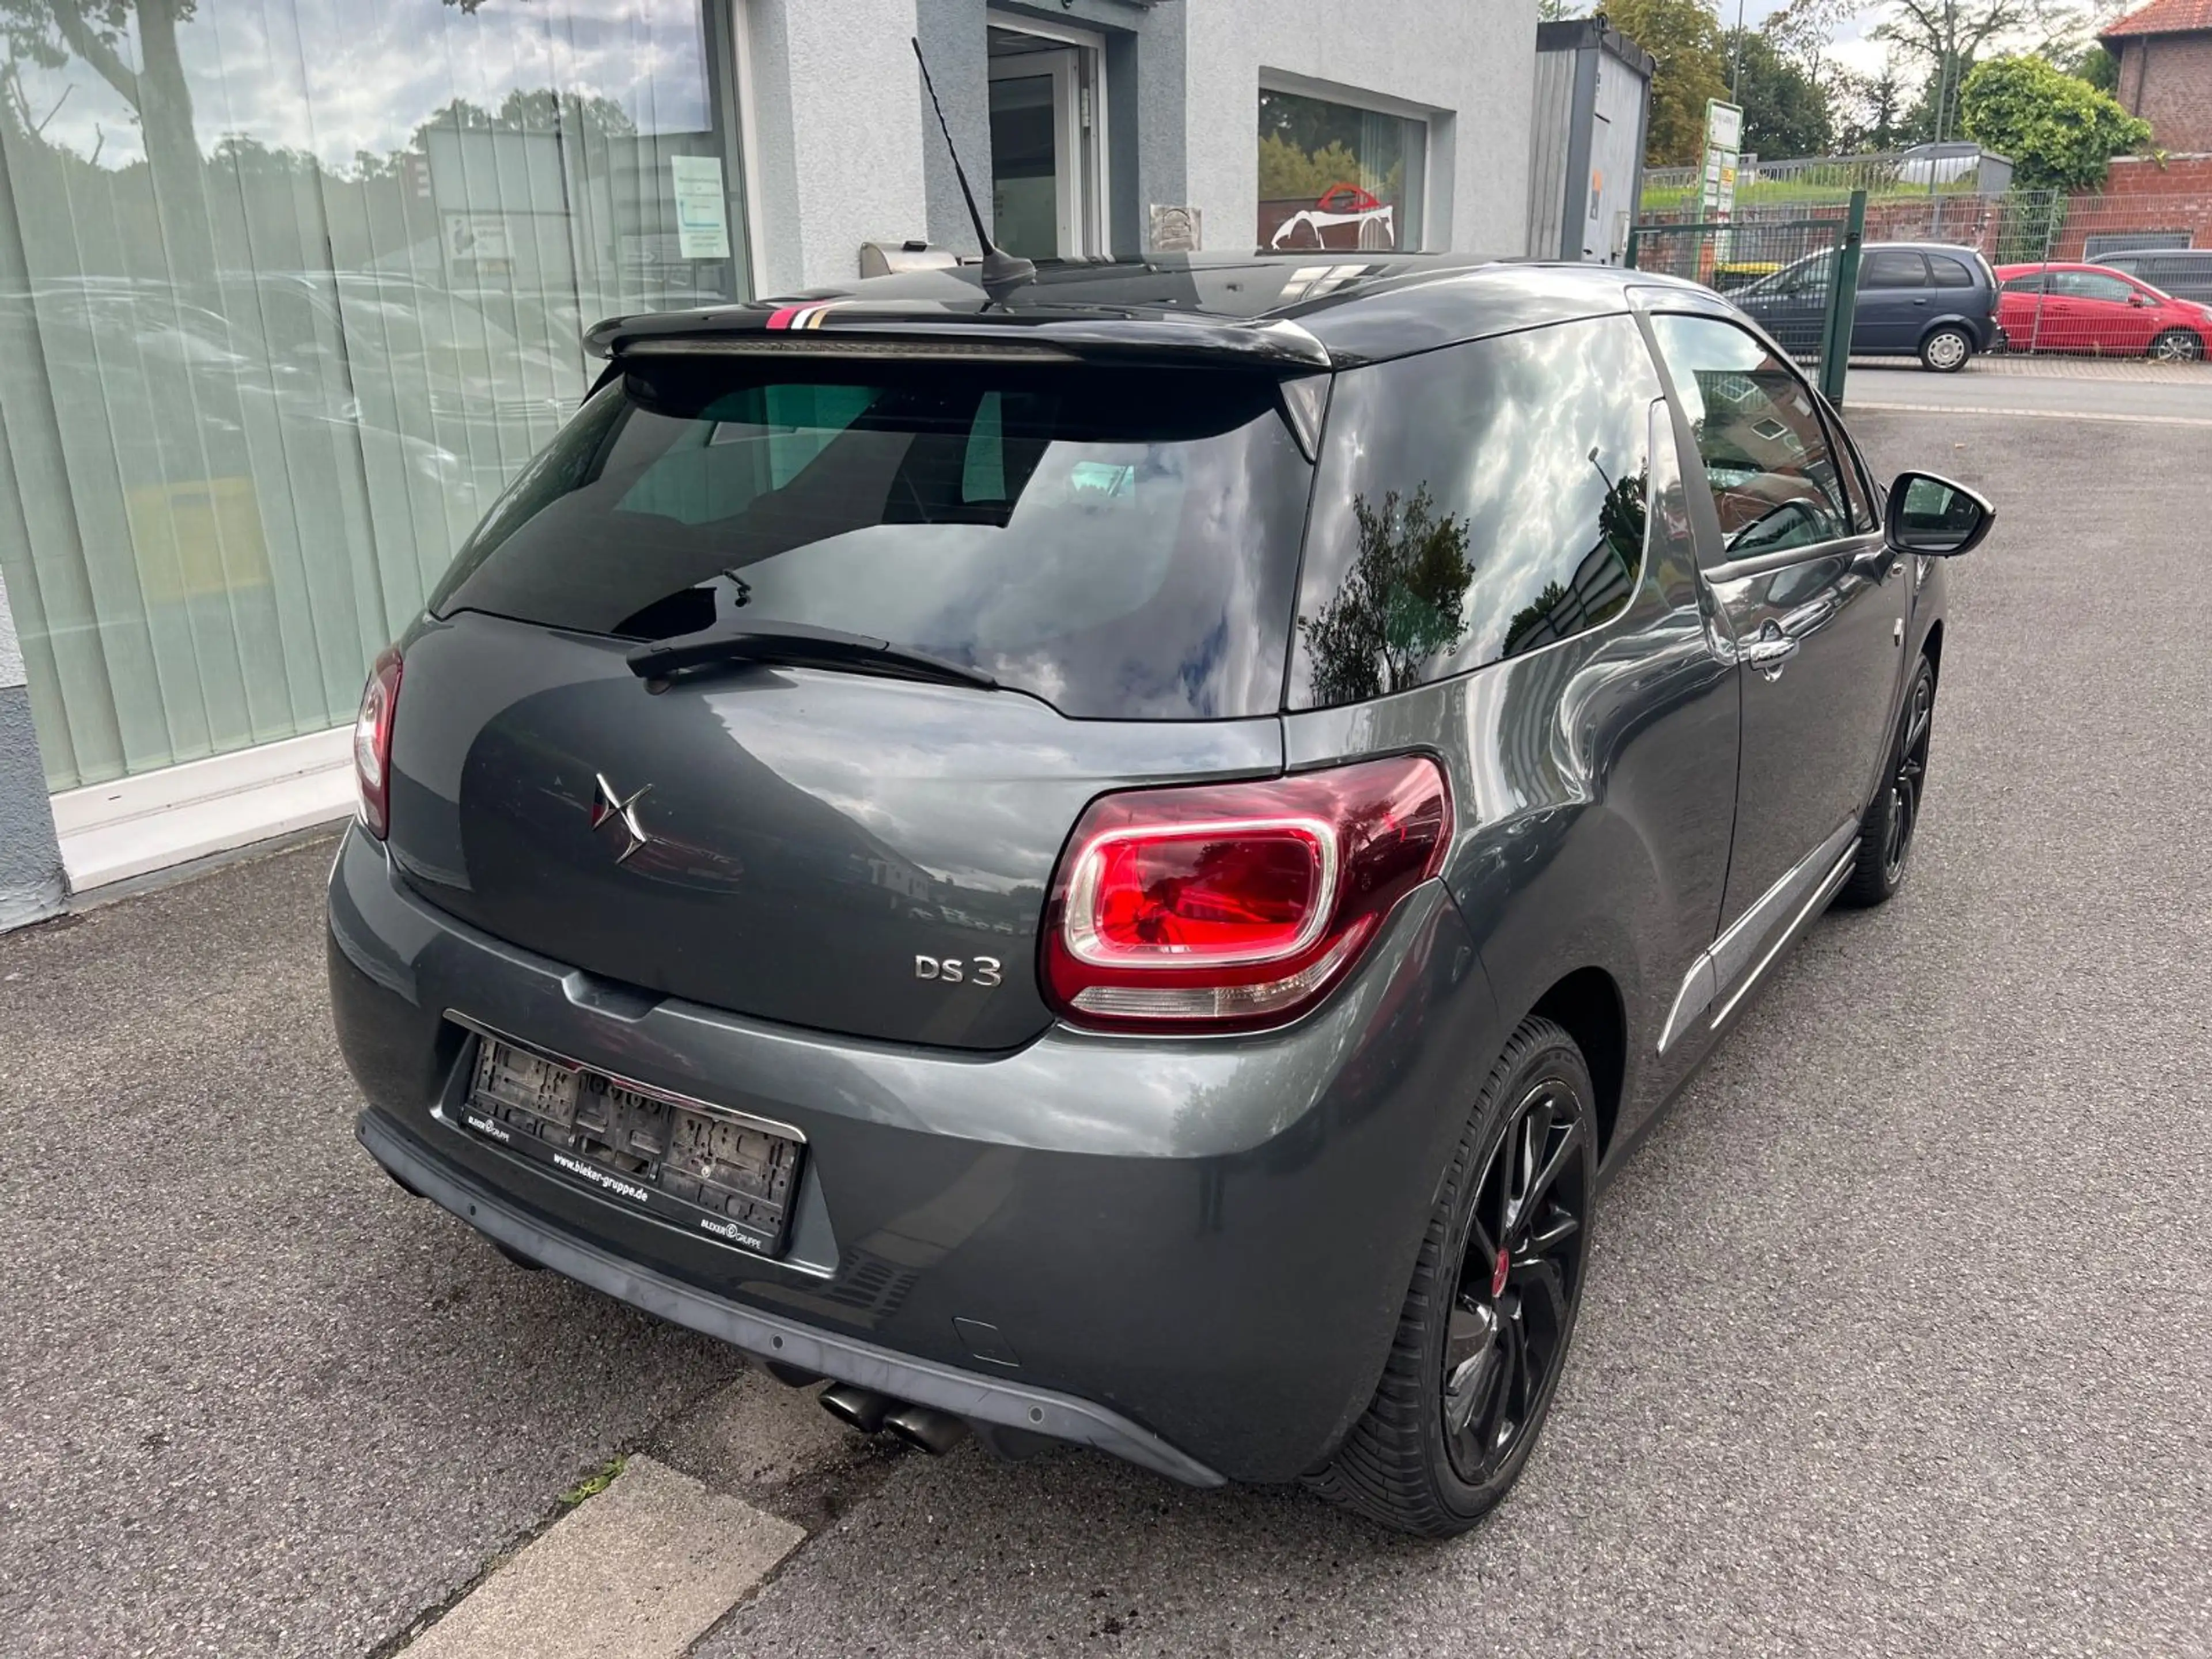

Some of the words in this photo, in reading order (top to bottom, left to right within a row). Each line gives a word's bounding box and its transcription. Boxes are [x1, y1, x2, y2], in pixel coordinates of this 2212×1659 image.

[915, 955, 963, 982] DS
[972, 956, 1002, 987] 3
[554, 1153, 648, 1202] www.bleker-gruppe.de
